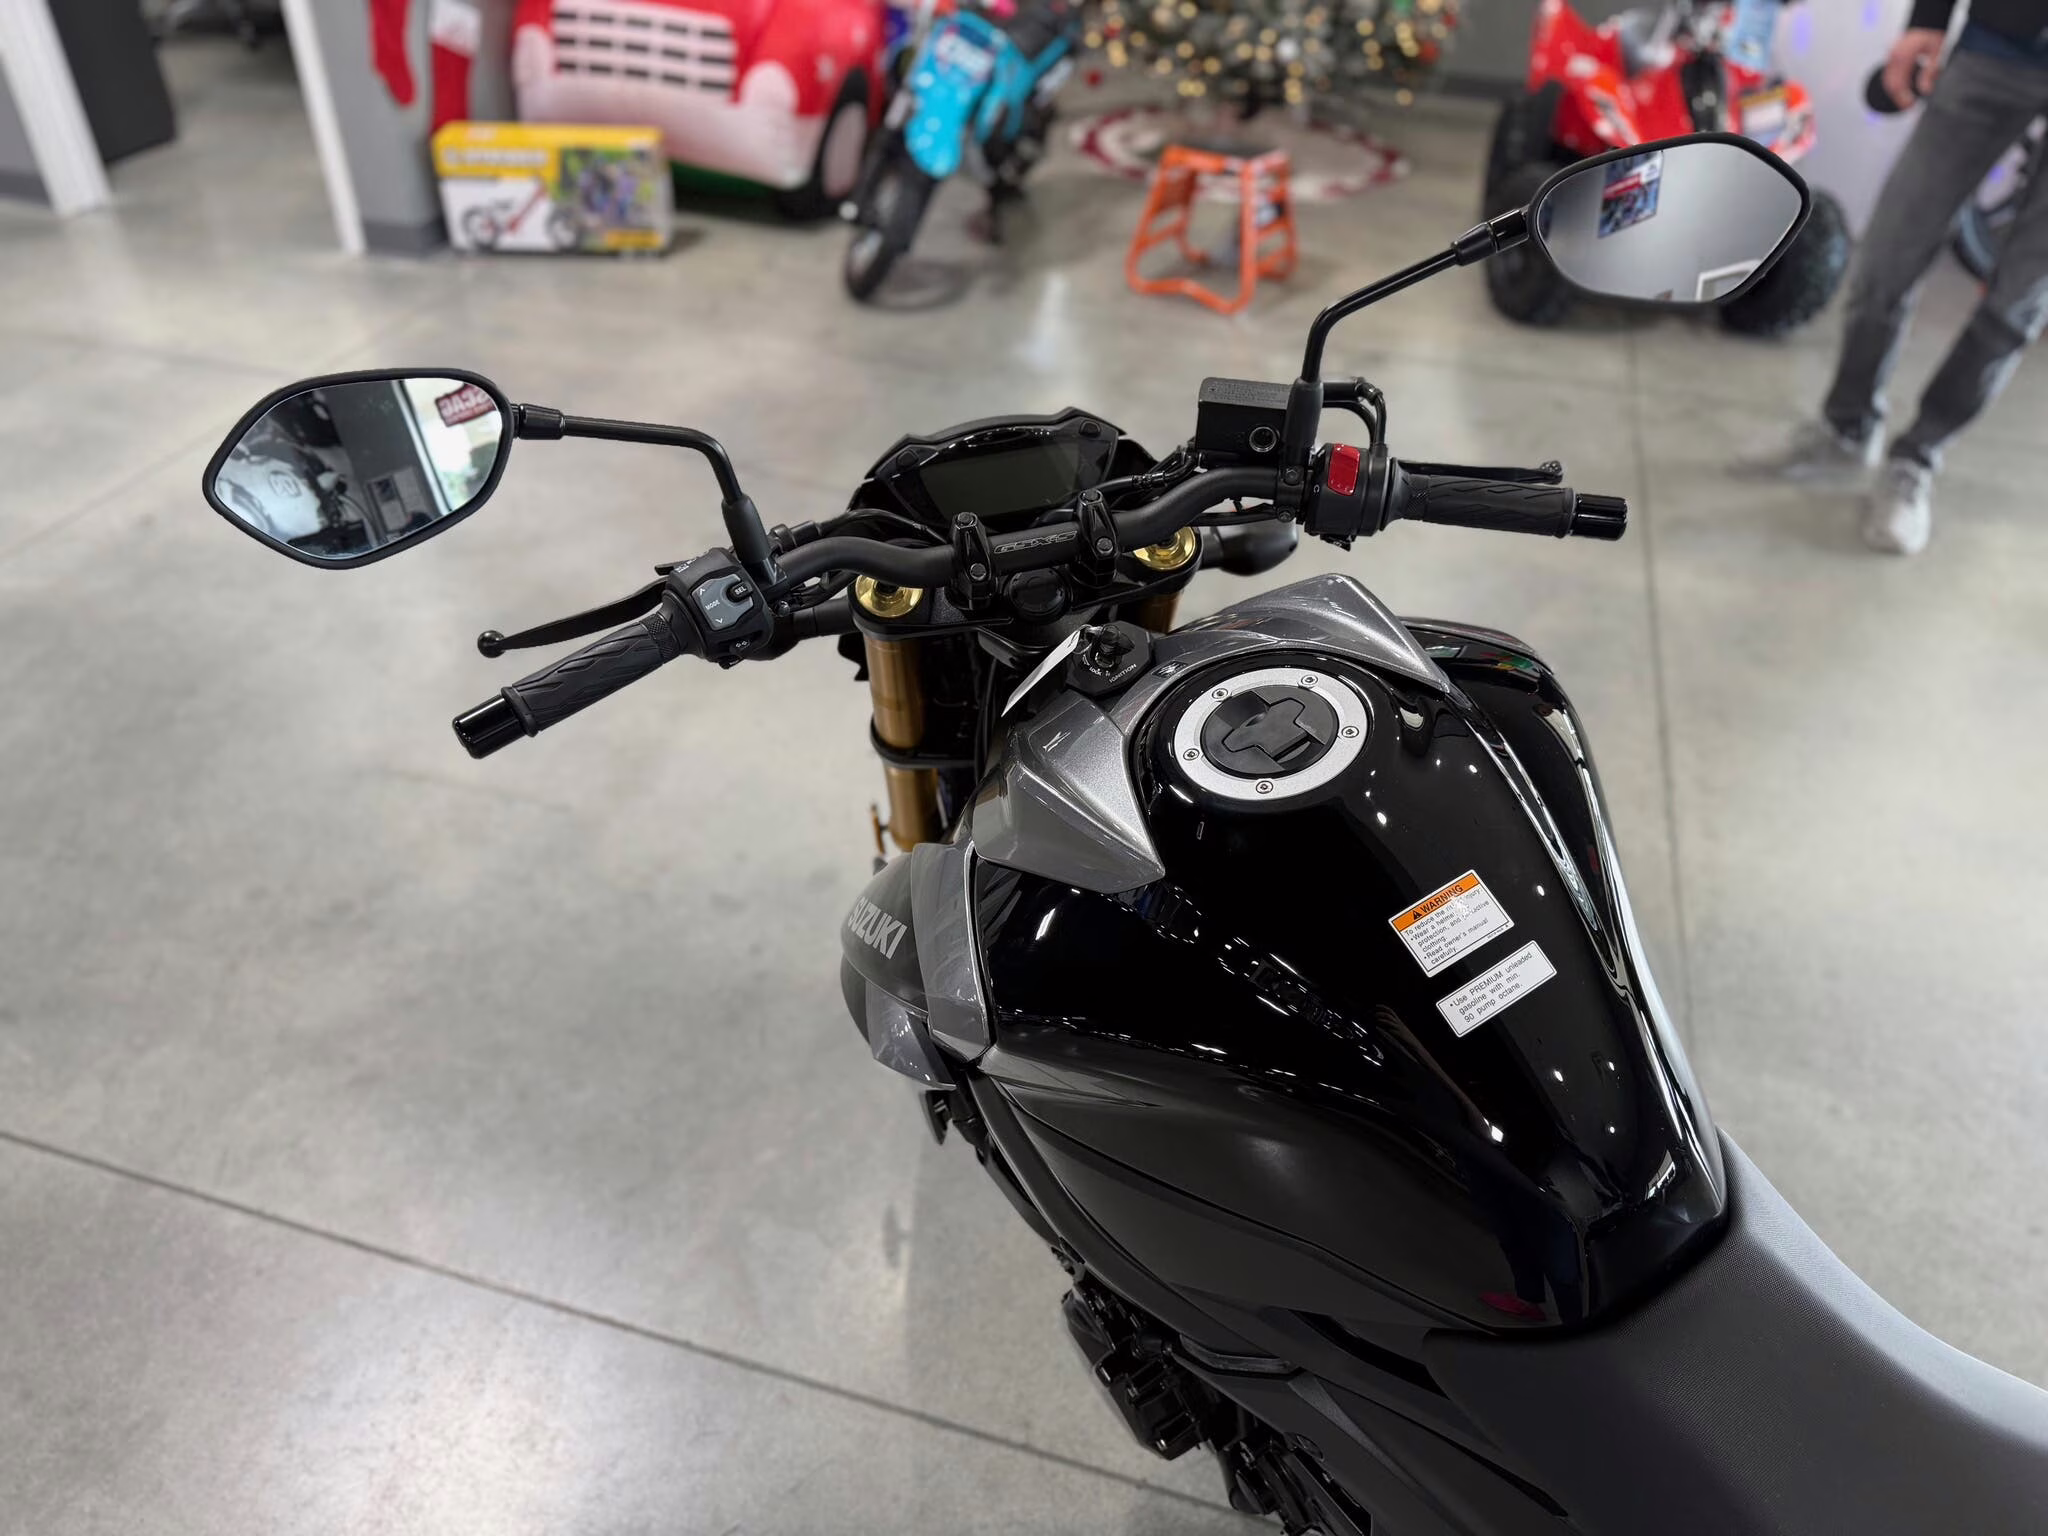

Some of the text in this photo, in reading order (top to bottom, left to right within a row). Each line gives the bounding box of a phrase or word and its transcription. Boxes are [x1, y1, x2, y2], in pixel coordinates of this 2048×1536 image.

[735, 586, 747, 595] SEL
[1109, 664, 1137, 683] IGNITION
[1420, 884, 1463, 913] WARNING
[847, 896, 908, 960] SUZUKI
[1414, 916, 1434, 931] reduce
[1434, 910, 1446, 919] the
[1450, 917, 1462, 928] and
[1412, 928, 1429, 940] Wear
[1423, 936, 1448, 953] clothing.
[1426, 946, 1443, 959] Read
[1444, 932, 1468, 948] owner's
[1468, 918, 1489, 935] manual
[1453, 952, 1532, 1007] Use PREMIUM unleaded
[1459, 972, 1521, 1015] gasoline with min.
[1464, 982, 1524, 1023] 90 pump octane.
